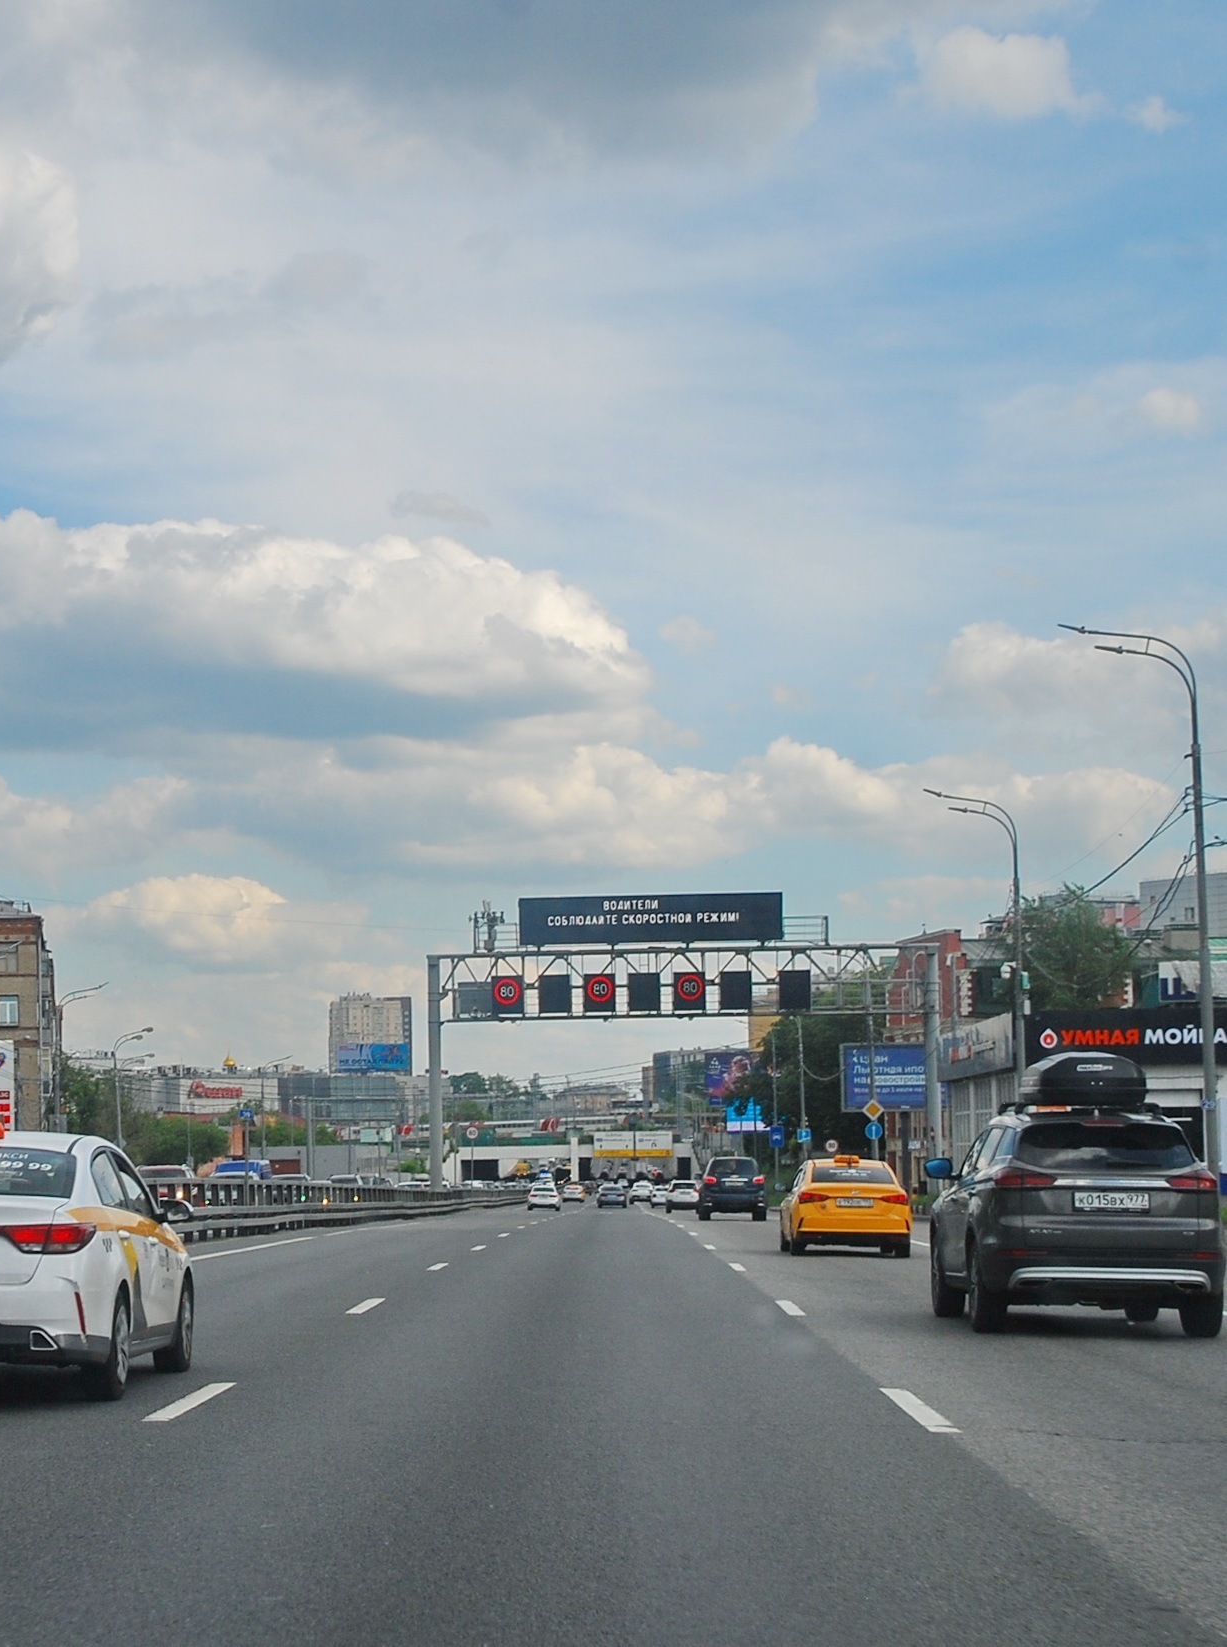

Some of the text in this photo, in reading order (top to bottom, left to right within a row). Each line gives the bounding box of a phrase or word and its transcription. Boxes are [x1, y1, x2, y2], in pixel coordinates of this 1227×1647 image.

[603, 899, 659, 912] ВОДИТЕЛИ
[547, 911, 740, 927] СОБЛЮДАЙТЕ СКОРОСТНОЙ РЕЖИМ!
[499, 986, 515, 998] 80
[593, 983, 608, 995] 80
[683, 982, 698, 993] 80
[1061, 1028, 1140, 1046] УМНАЯ
[0, 1160, 24, 1168] 99
[27, 1162, 53, 1171] 99
